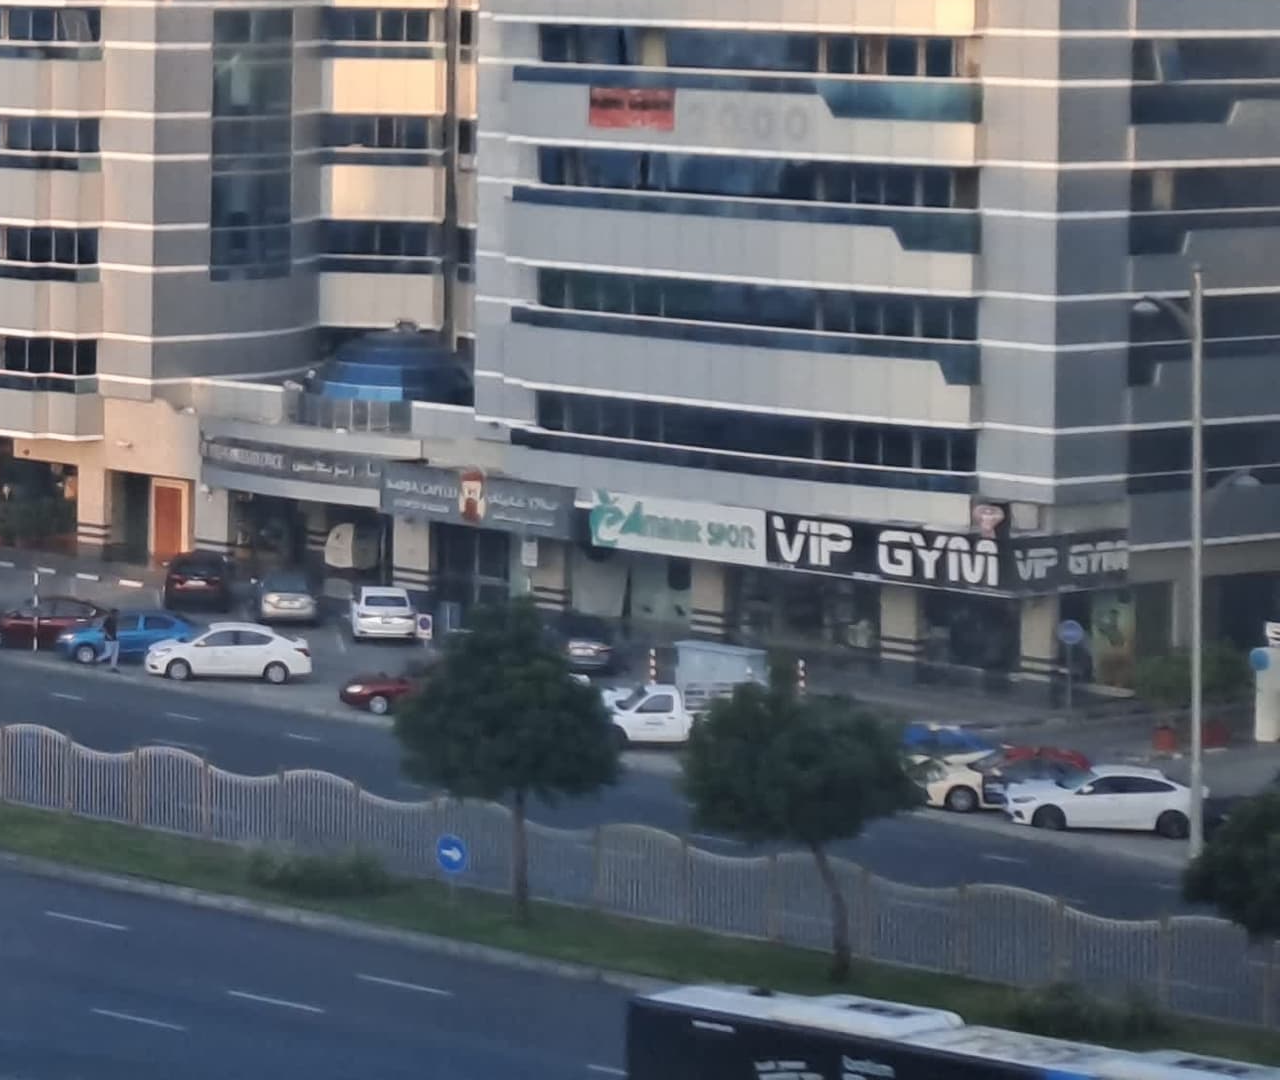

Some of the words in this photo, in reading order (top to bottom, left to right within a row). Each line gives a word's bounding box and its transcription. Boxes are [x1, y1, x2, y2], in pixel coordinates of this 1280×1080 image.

[772, 515, 854, 567] VIP
[877, 530, 1000, 586] GYM
[1014, 546, 1058, 581] VIP
[1068, 540, 1130, 576] GYM
